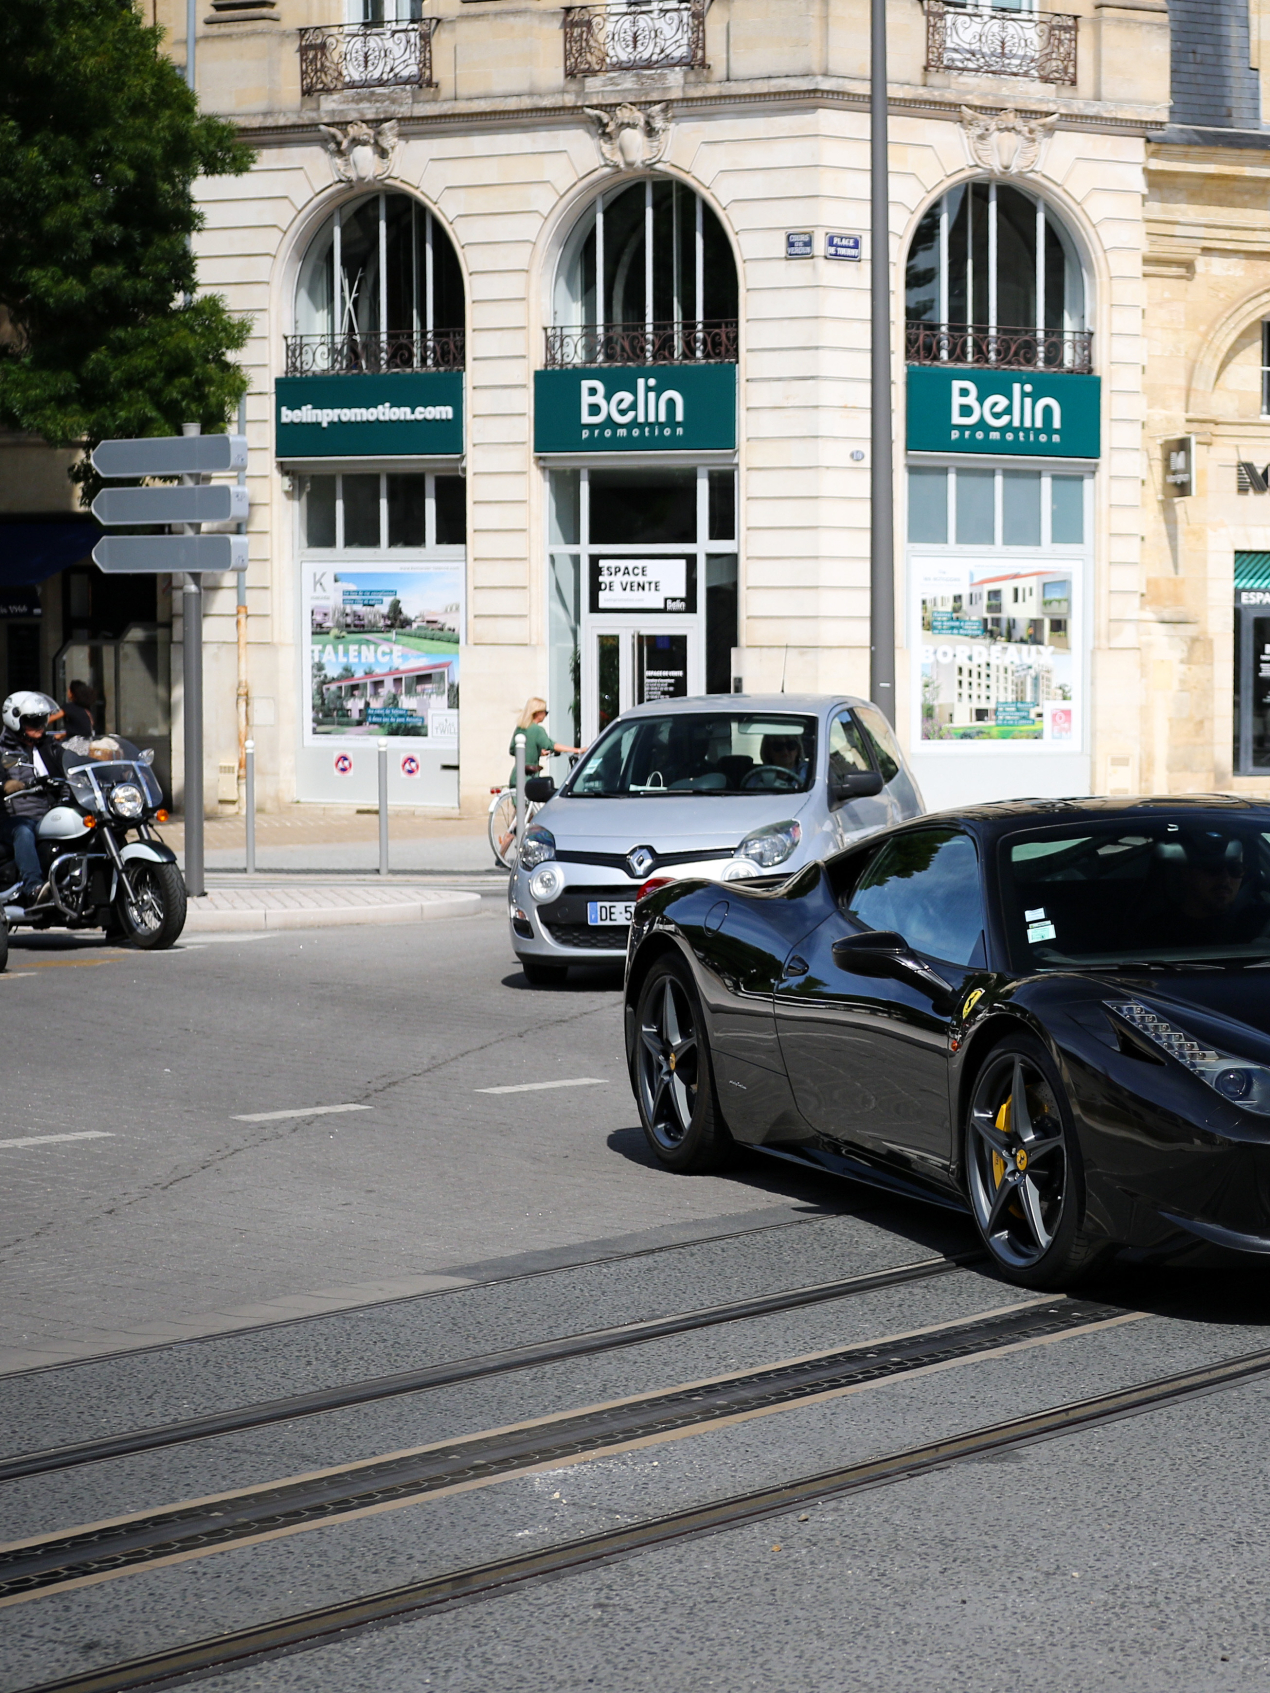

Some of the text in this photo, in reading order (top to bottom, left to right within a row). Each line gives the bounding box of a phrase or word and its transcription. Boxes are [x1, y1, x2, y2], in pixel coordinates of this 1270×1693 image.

[833, 236, 854, 246] PLACE
[837, 248, 858, 256] TOURNY
[580, 377, 685, 425] Belin
[951, 380, 1062, 430] Belin
[280, 402, 453, 428] belinpromotion.com
[582, 426, 684, 440] promotion
[951, 428, 1061, 443] promotion
[600, 566, 648, 576] ESPACE
[600, 581, 660, 592] DE VENTE
[666, 599, 686, 608] Belin
[312, 644, 402, 663] TALENCE
[922, 644, 1054, 664] BORDEAUX
[600, 905, 635, 921] DE-5
